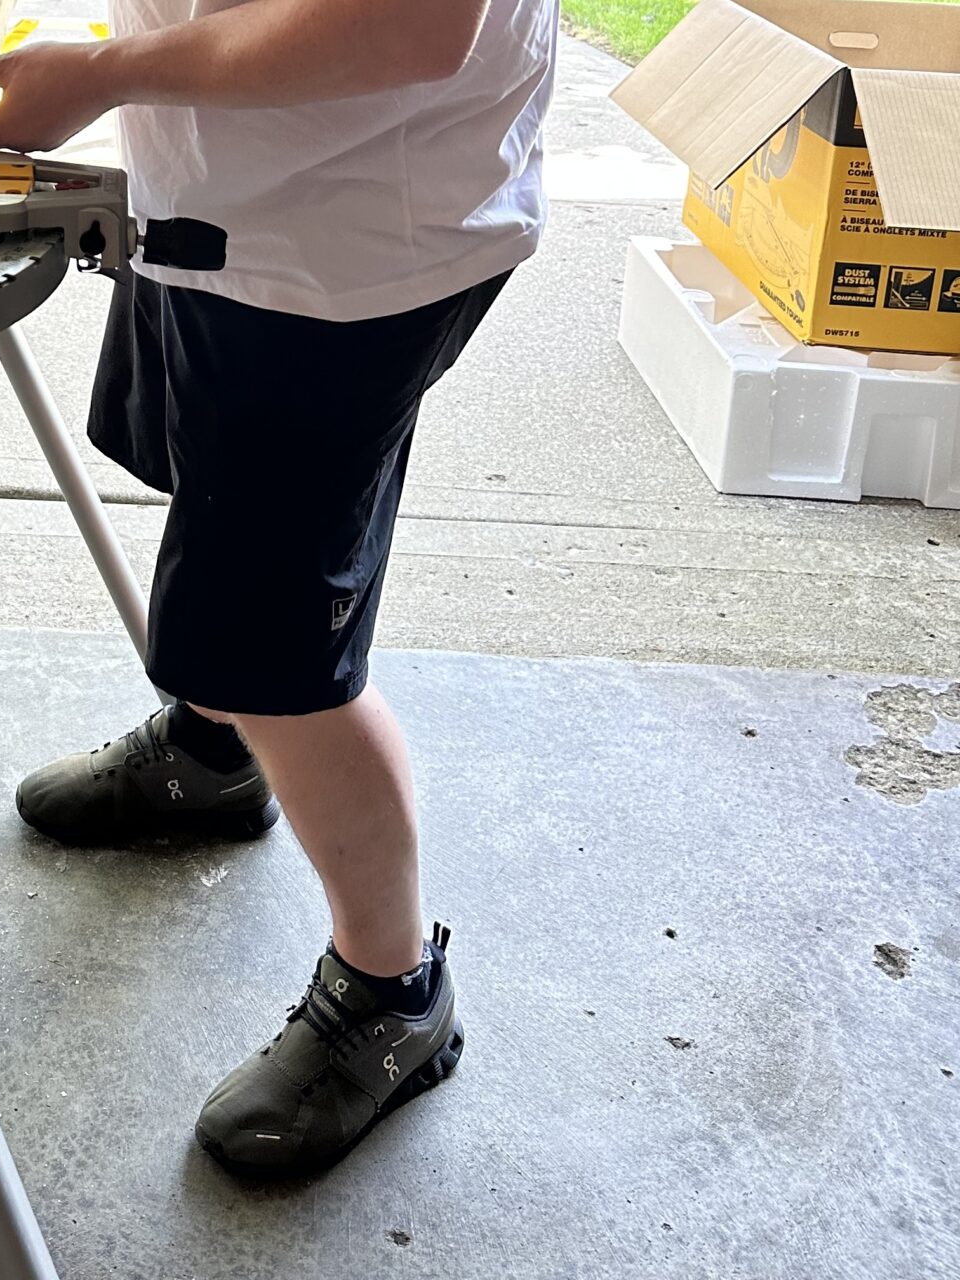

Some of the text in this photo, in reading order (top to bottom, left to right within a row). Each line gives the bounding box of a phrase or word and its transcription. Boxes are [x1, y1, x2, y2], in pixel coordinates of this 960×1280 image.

[844, 189, 858, 197] DE
[843, 197, 877, 206] SIERRA
[850, 217, 884, 226] BISEAU
[840, 225, 862, 233] SCIE
[873, 227, 916, 237] ONGLETS
[918, 230, 948, 239] MIXTE
[844, 268, 871, 278] DUST
[837, 276, 875, 286] SYSTEM
[831, 294, 875, 303] COMPATIBLE
